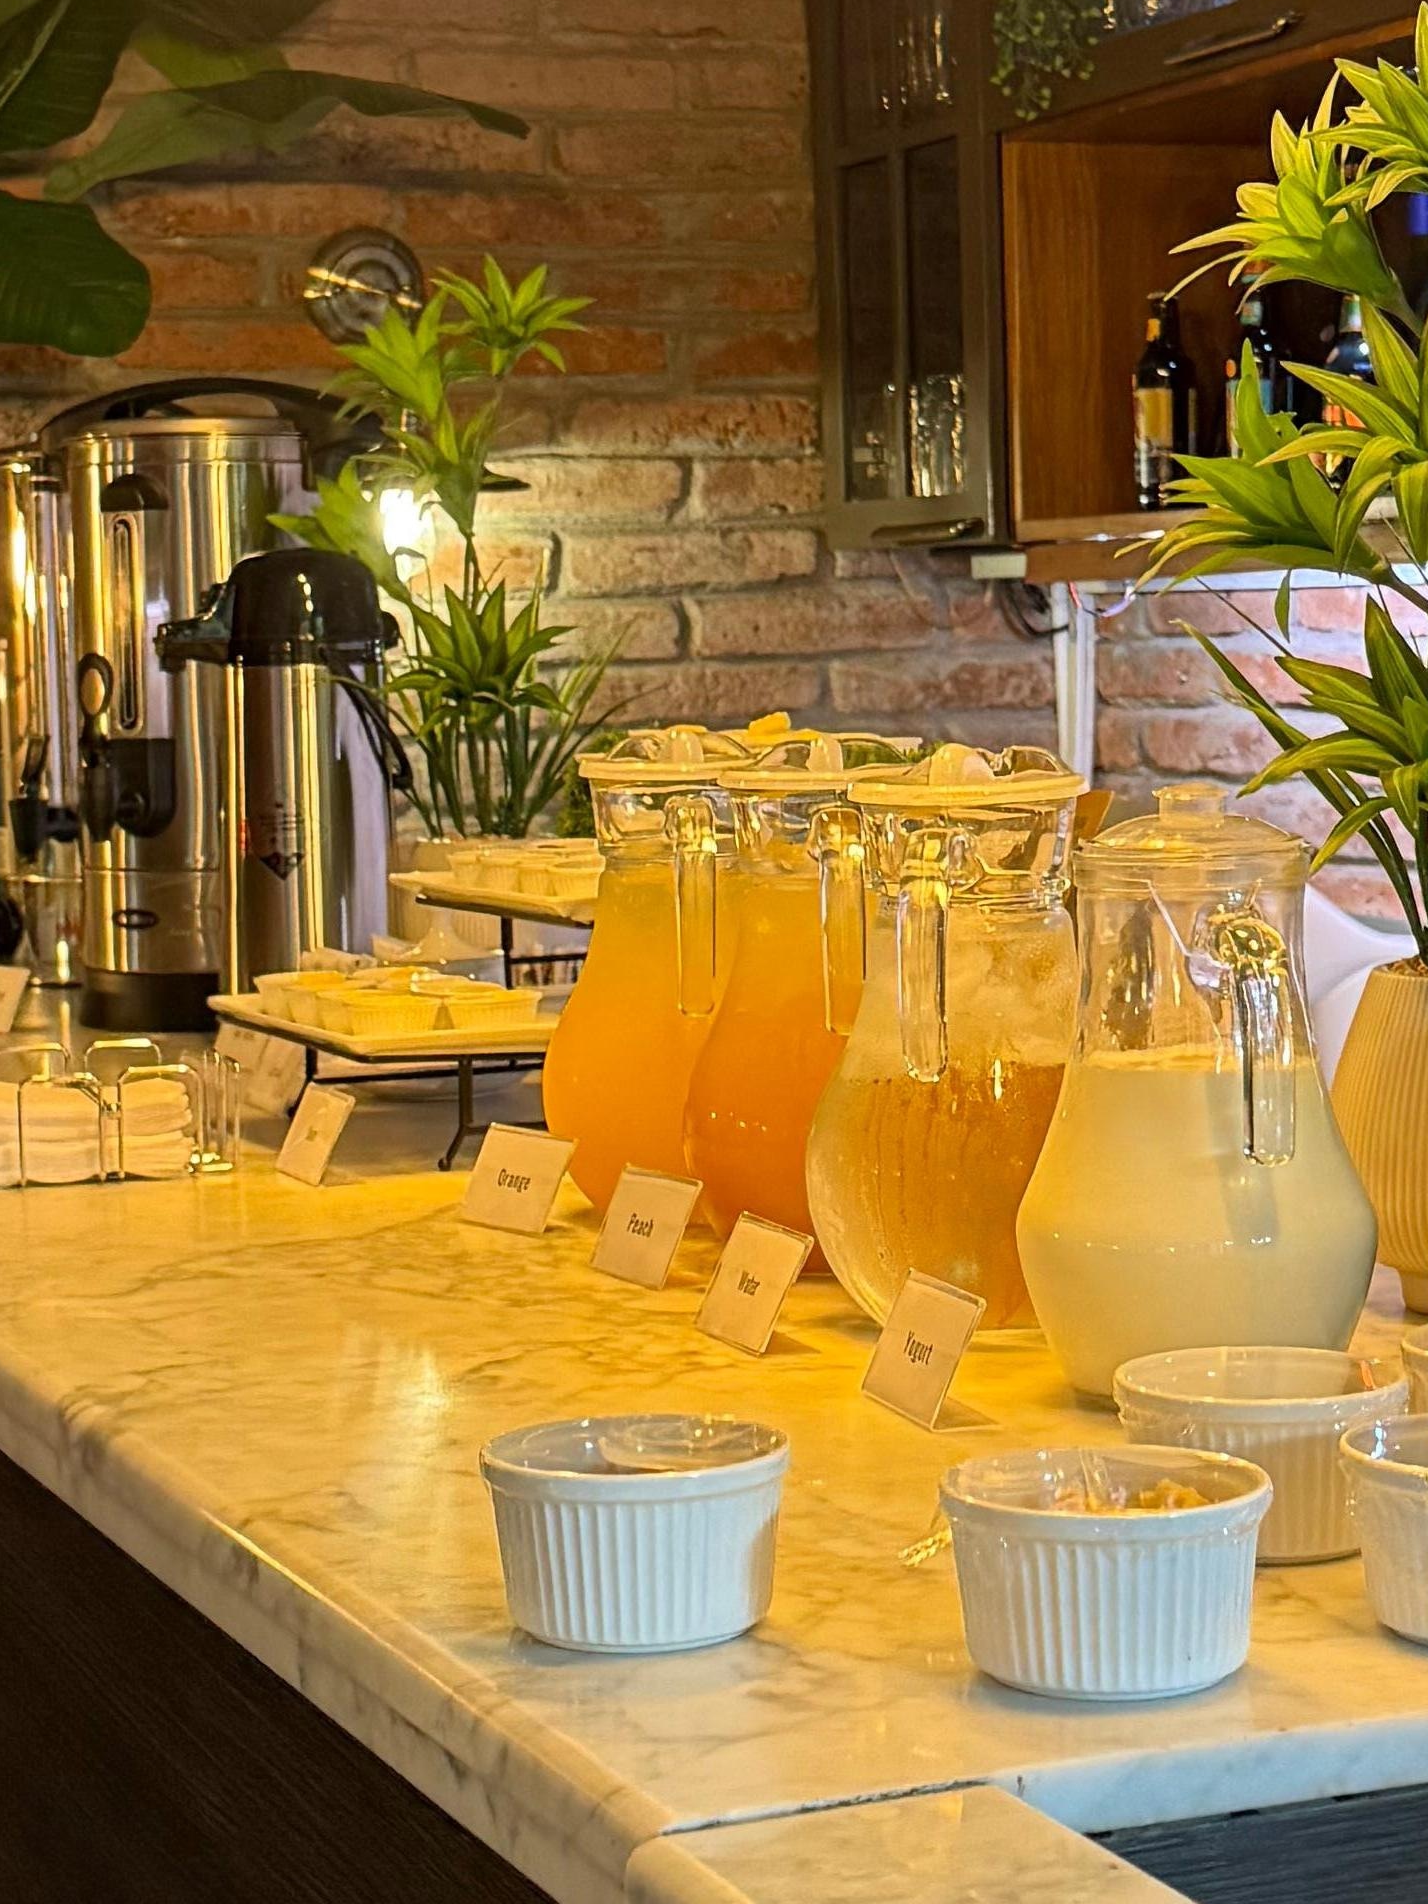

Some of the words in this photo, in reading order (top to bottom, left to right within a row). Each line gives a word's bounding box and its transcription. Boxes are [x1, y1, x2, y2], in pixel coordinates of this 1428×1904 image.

[497, 1168, 531, 1193] Orange
[626, 1212, 655, 1238] Peach
[736, 1269, 761, 1296] Water
[903, 1329, 934, 1365] Yogurt
